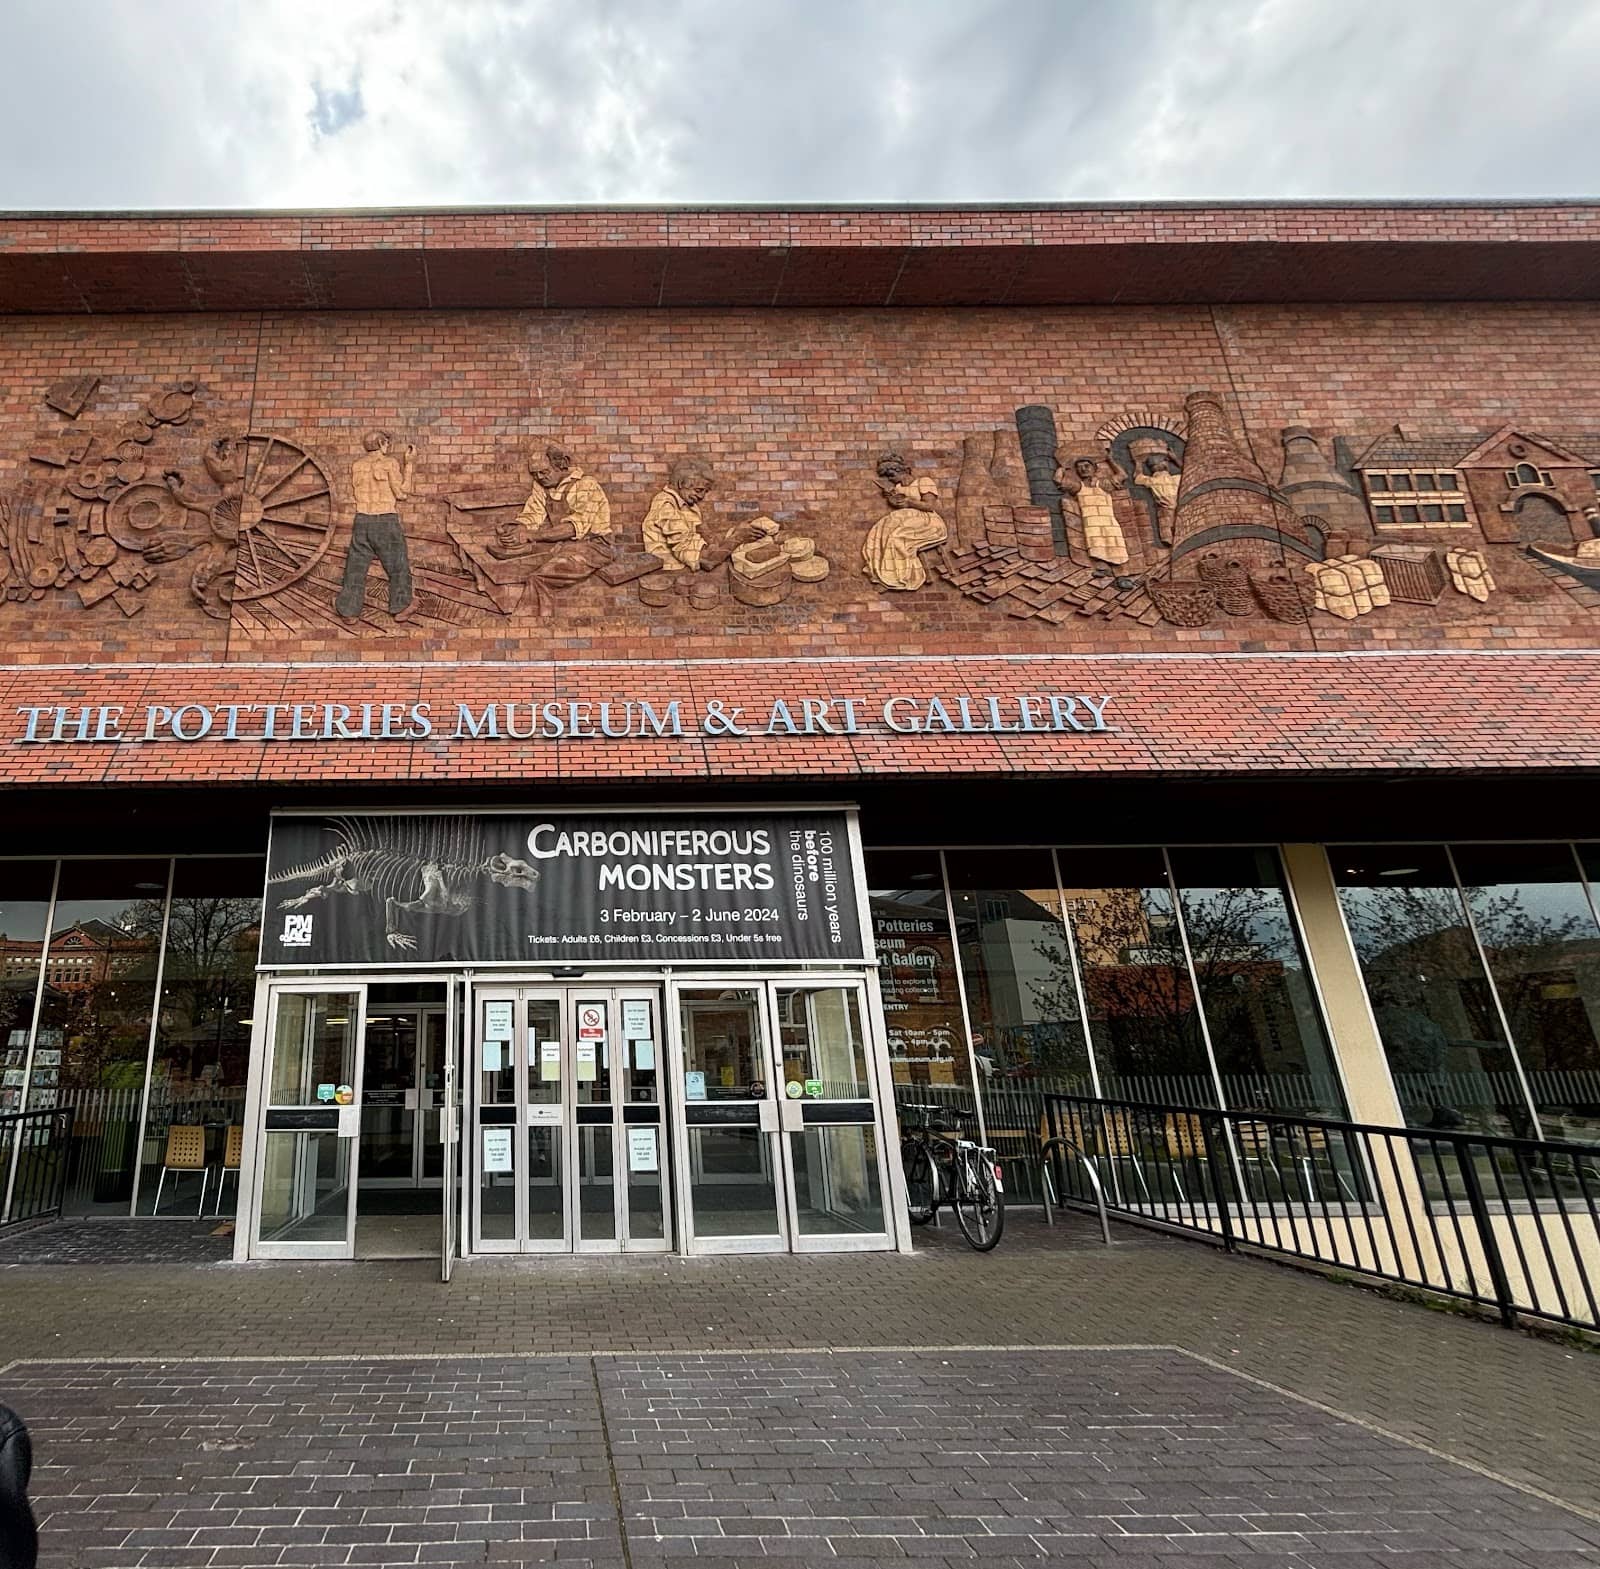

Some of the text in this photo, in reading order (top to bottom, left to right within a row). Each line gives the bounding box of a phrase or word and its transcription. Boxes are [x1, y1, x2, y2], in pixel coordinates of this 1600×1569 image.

[14, 694, 1114, 743] THE POTTERIES MUSEUM & ART GALLERY
[804, 830, 820, 882] before
[598, 863, 775, 891] MONSTERS
[789, 830, 809, 921] the dinosaurs
[819, 830, 842, 943] 100 million years
[600, 910, 610, 922] 3
[613, 909, 677, 925] February
[692, 910, 702, 922] 2
[705, 909, 741, 922] June
[744, 909, 780, 922] 2024
[877, 919, 934, 932] Potteries
[527, 934, 783, 945] Tickets: Adults £6, Children £3, Concessions £3, Under 5s free
[873, 938, 906, 949] seum
[891, 952, 936, 969] Gallery
